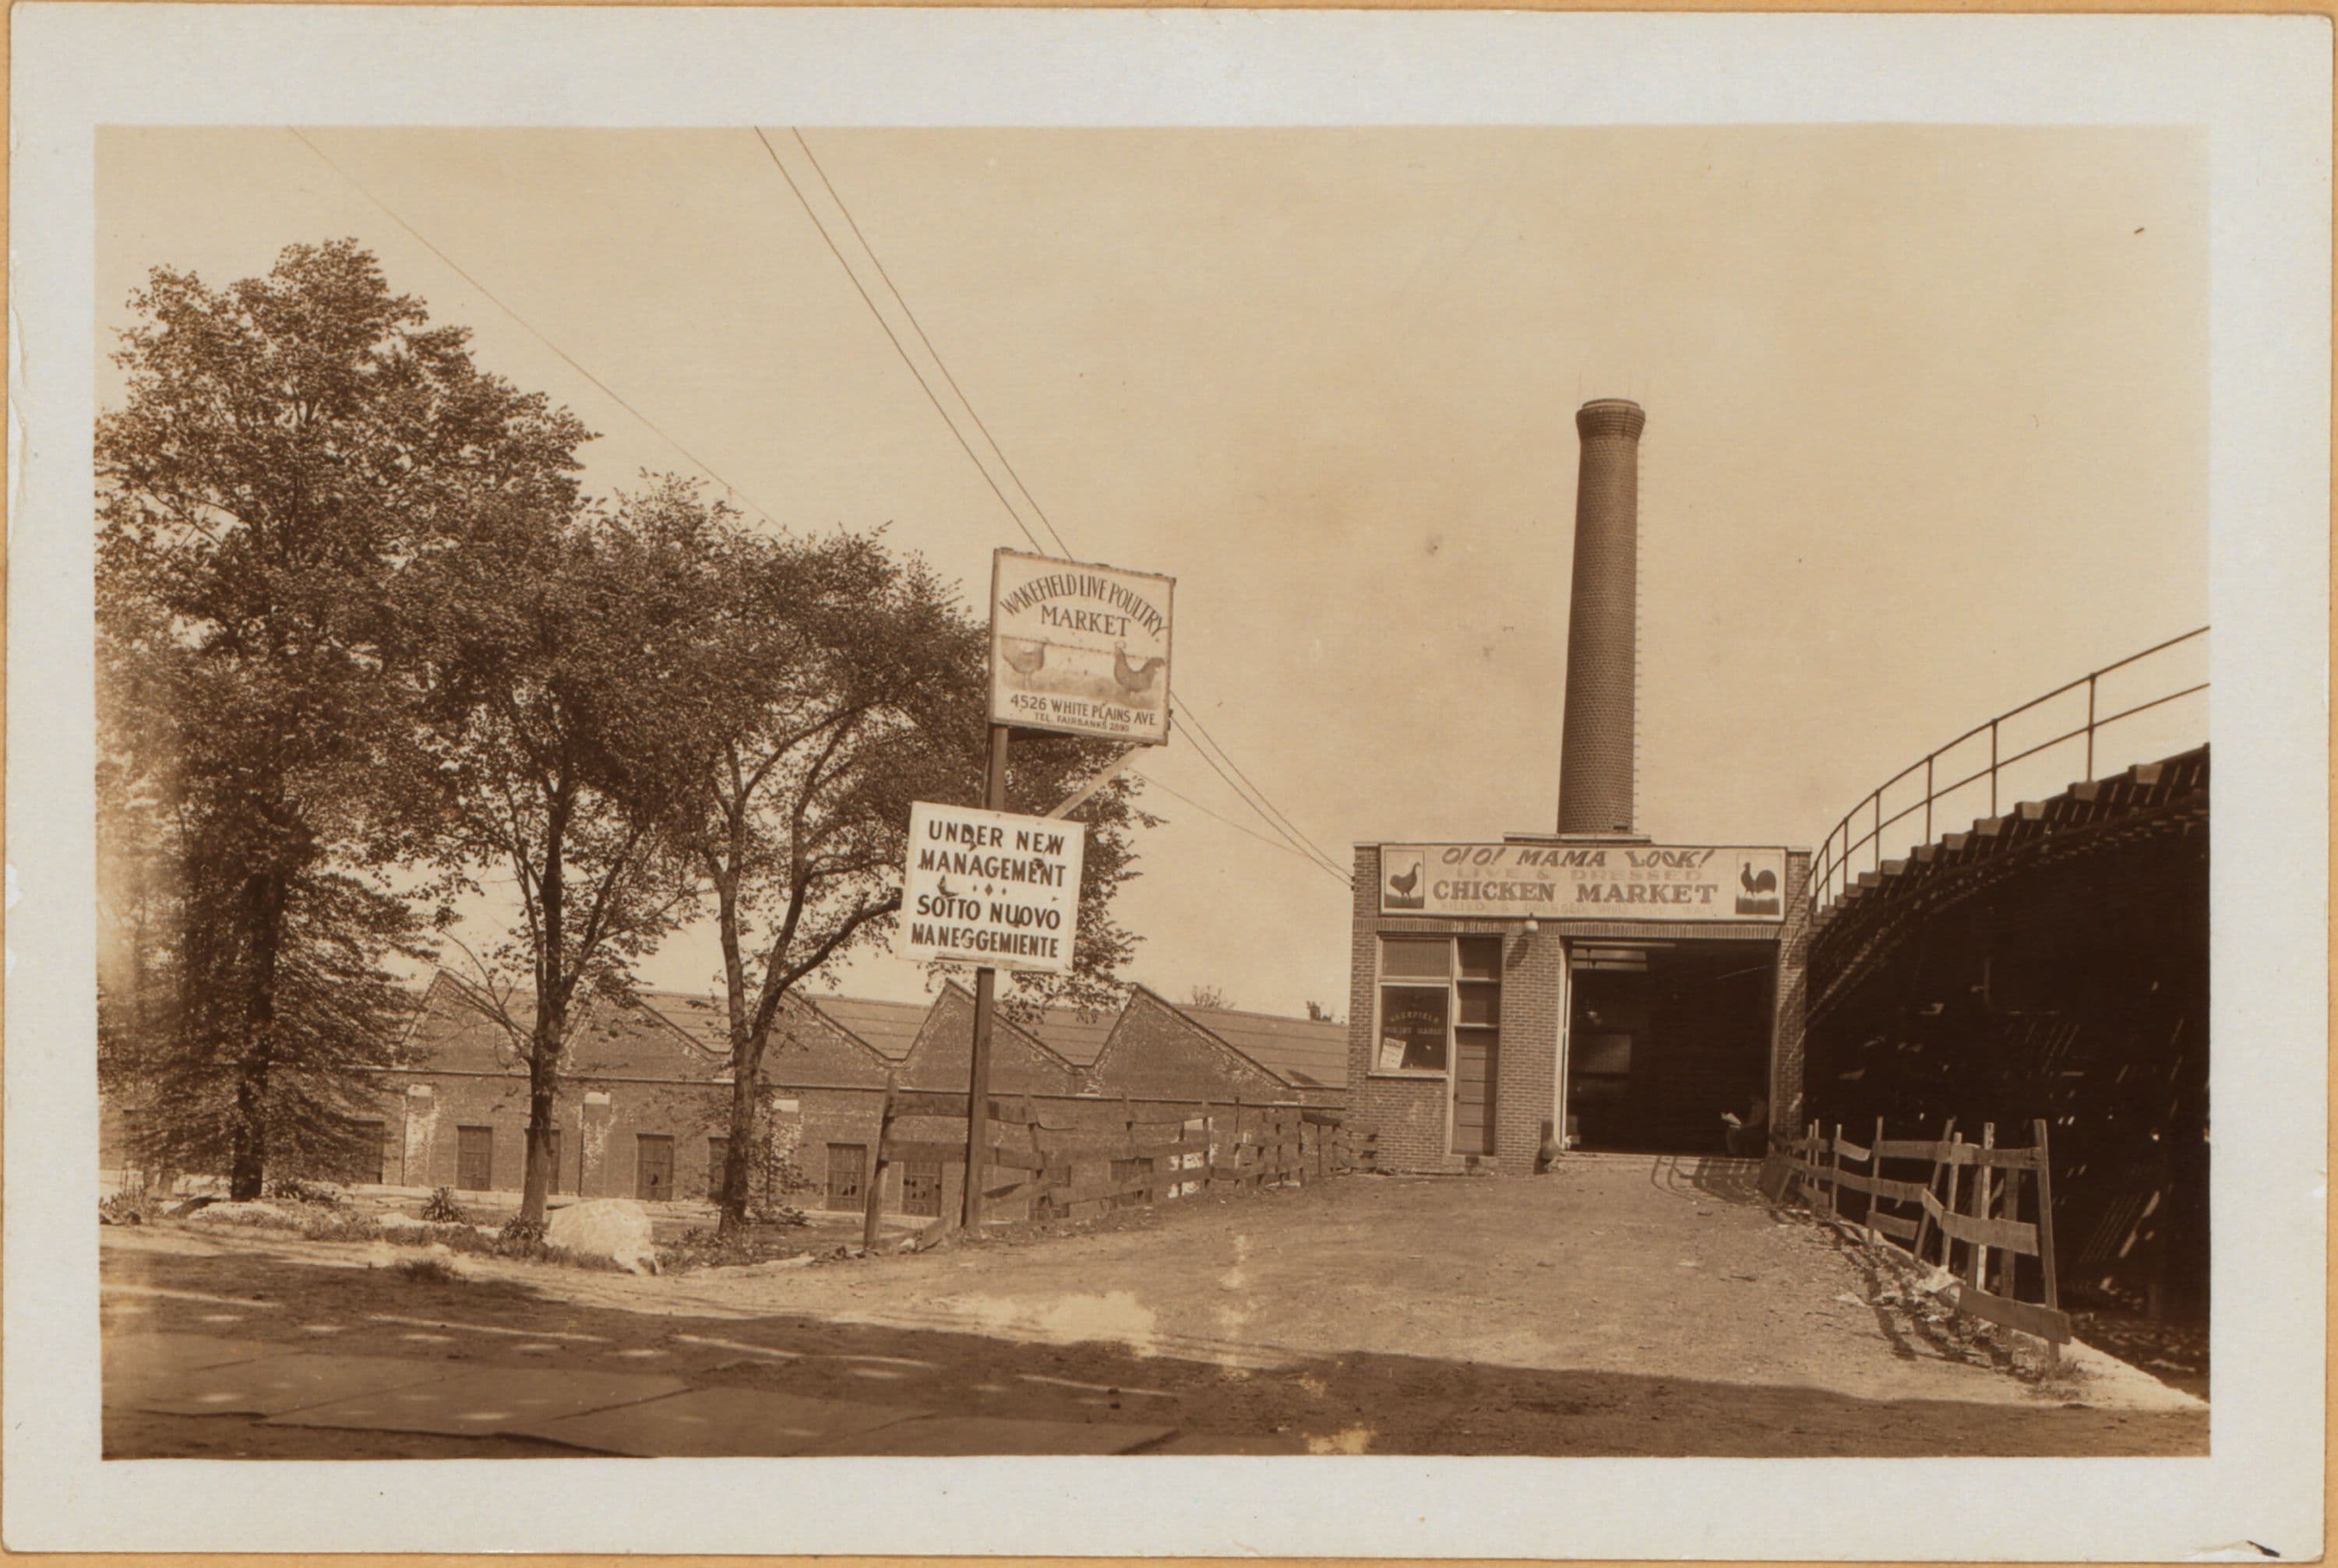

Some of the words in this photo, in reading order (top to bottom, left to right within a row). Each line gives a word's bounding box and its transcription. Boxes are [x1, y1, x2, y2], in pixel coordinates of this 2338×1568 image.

[1000, 574, 1077, 617] WAKEFIELD
[1080, 575, 1107, 599] LIVE
[1108, 582, 1168, 636] POULTRY
[1041, 604, 1131, 636] MARKET
[1010, 694, 1046, 710] 4526
[1051, 699, 1088, 717] WHITE
[1091, 705, 1130, 724] PLAINS
[1057, 714, 1107, 730] FAIRBANKS
[929, 820, 1003, 847] UNDER
[1016, 830, 1065, 855] NEW
[919, 849, 1066, 887] MANAGEMENT
[1457, 868, 1519, 879] LIVE
[1537, 869, 1550, 879] &
[1571, 869, 1701, 880] DRESSED
[1516, 850, 1606, 866] MAMA
[1624, 849, 1715, 868] LOOK!
[1433, 879, 1556, 902] CHICKEN
[1575, 883, 1719, 904] MARKET
[916, 894, 981, 921] SOTTO
[989, 902, 1060, 930] NUOVO
[911, 923, 1059, 958] MANEGGEMIENTE
